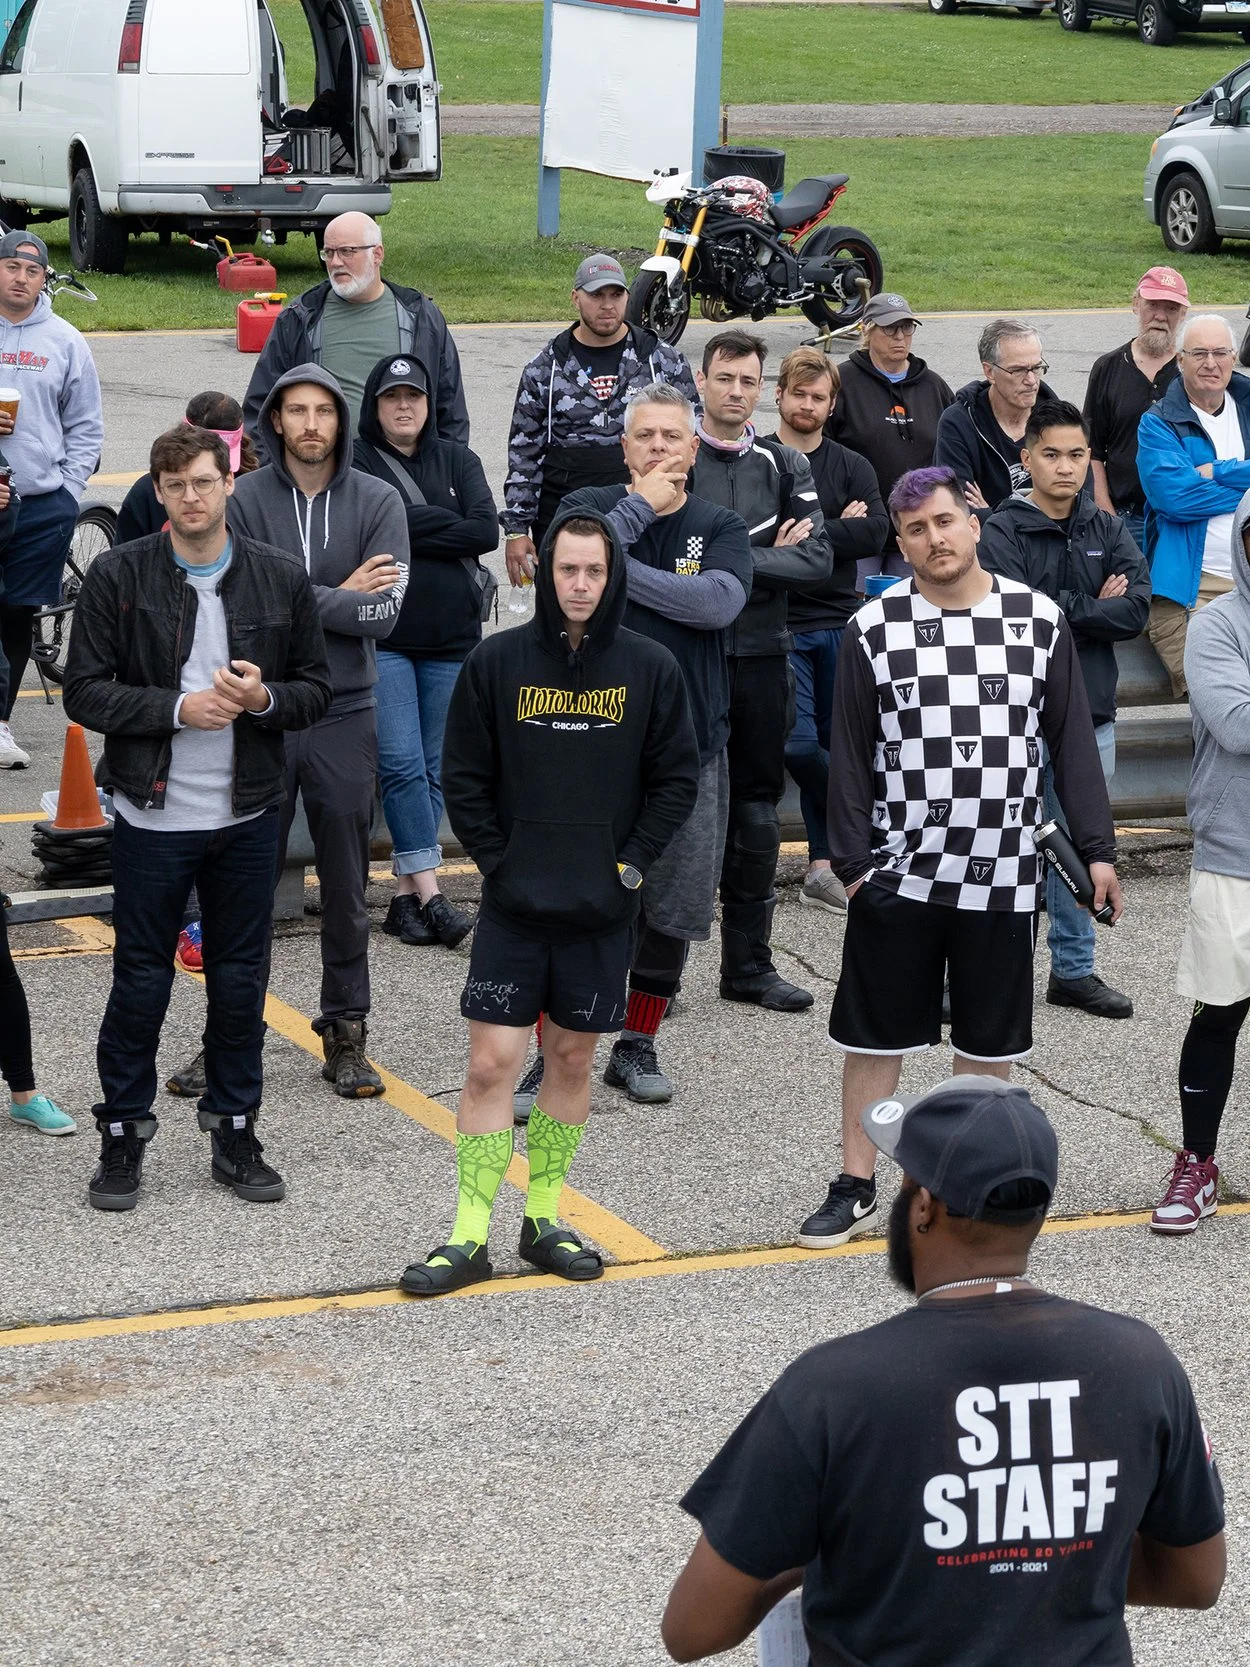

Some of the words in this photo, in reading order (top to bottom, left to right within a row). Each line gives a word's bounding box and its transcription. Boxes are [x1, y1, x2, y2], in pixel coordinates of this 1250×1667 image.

[675, 558, 686, 568] 15
[358, 599, 395, 621] HEAVY
[518, 686, 627, 723] MOTOWORKS
[552, 721, 589, 731] CHICAGO
[1055, 863, 1079, 893] SUBARU
[955, 1379, 1080, 1466] STT
[923, 1460, 1118, 1549] STAFF
[937, 1547, 1028, 1566] CELEBRATING
[1035, 1547, 1053, 1559] 20
[1059, 1539, 1093, 1557] YEARS
[989, 1562, 1014, 1574] 2001
[1022, 1562, 1048, 1573] 2021
